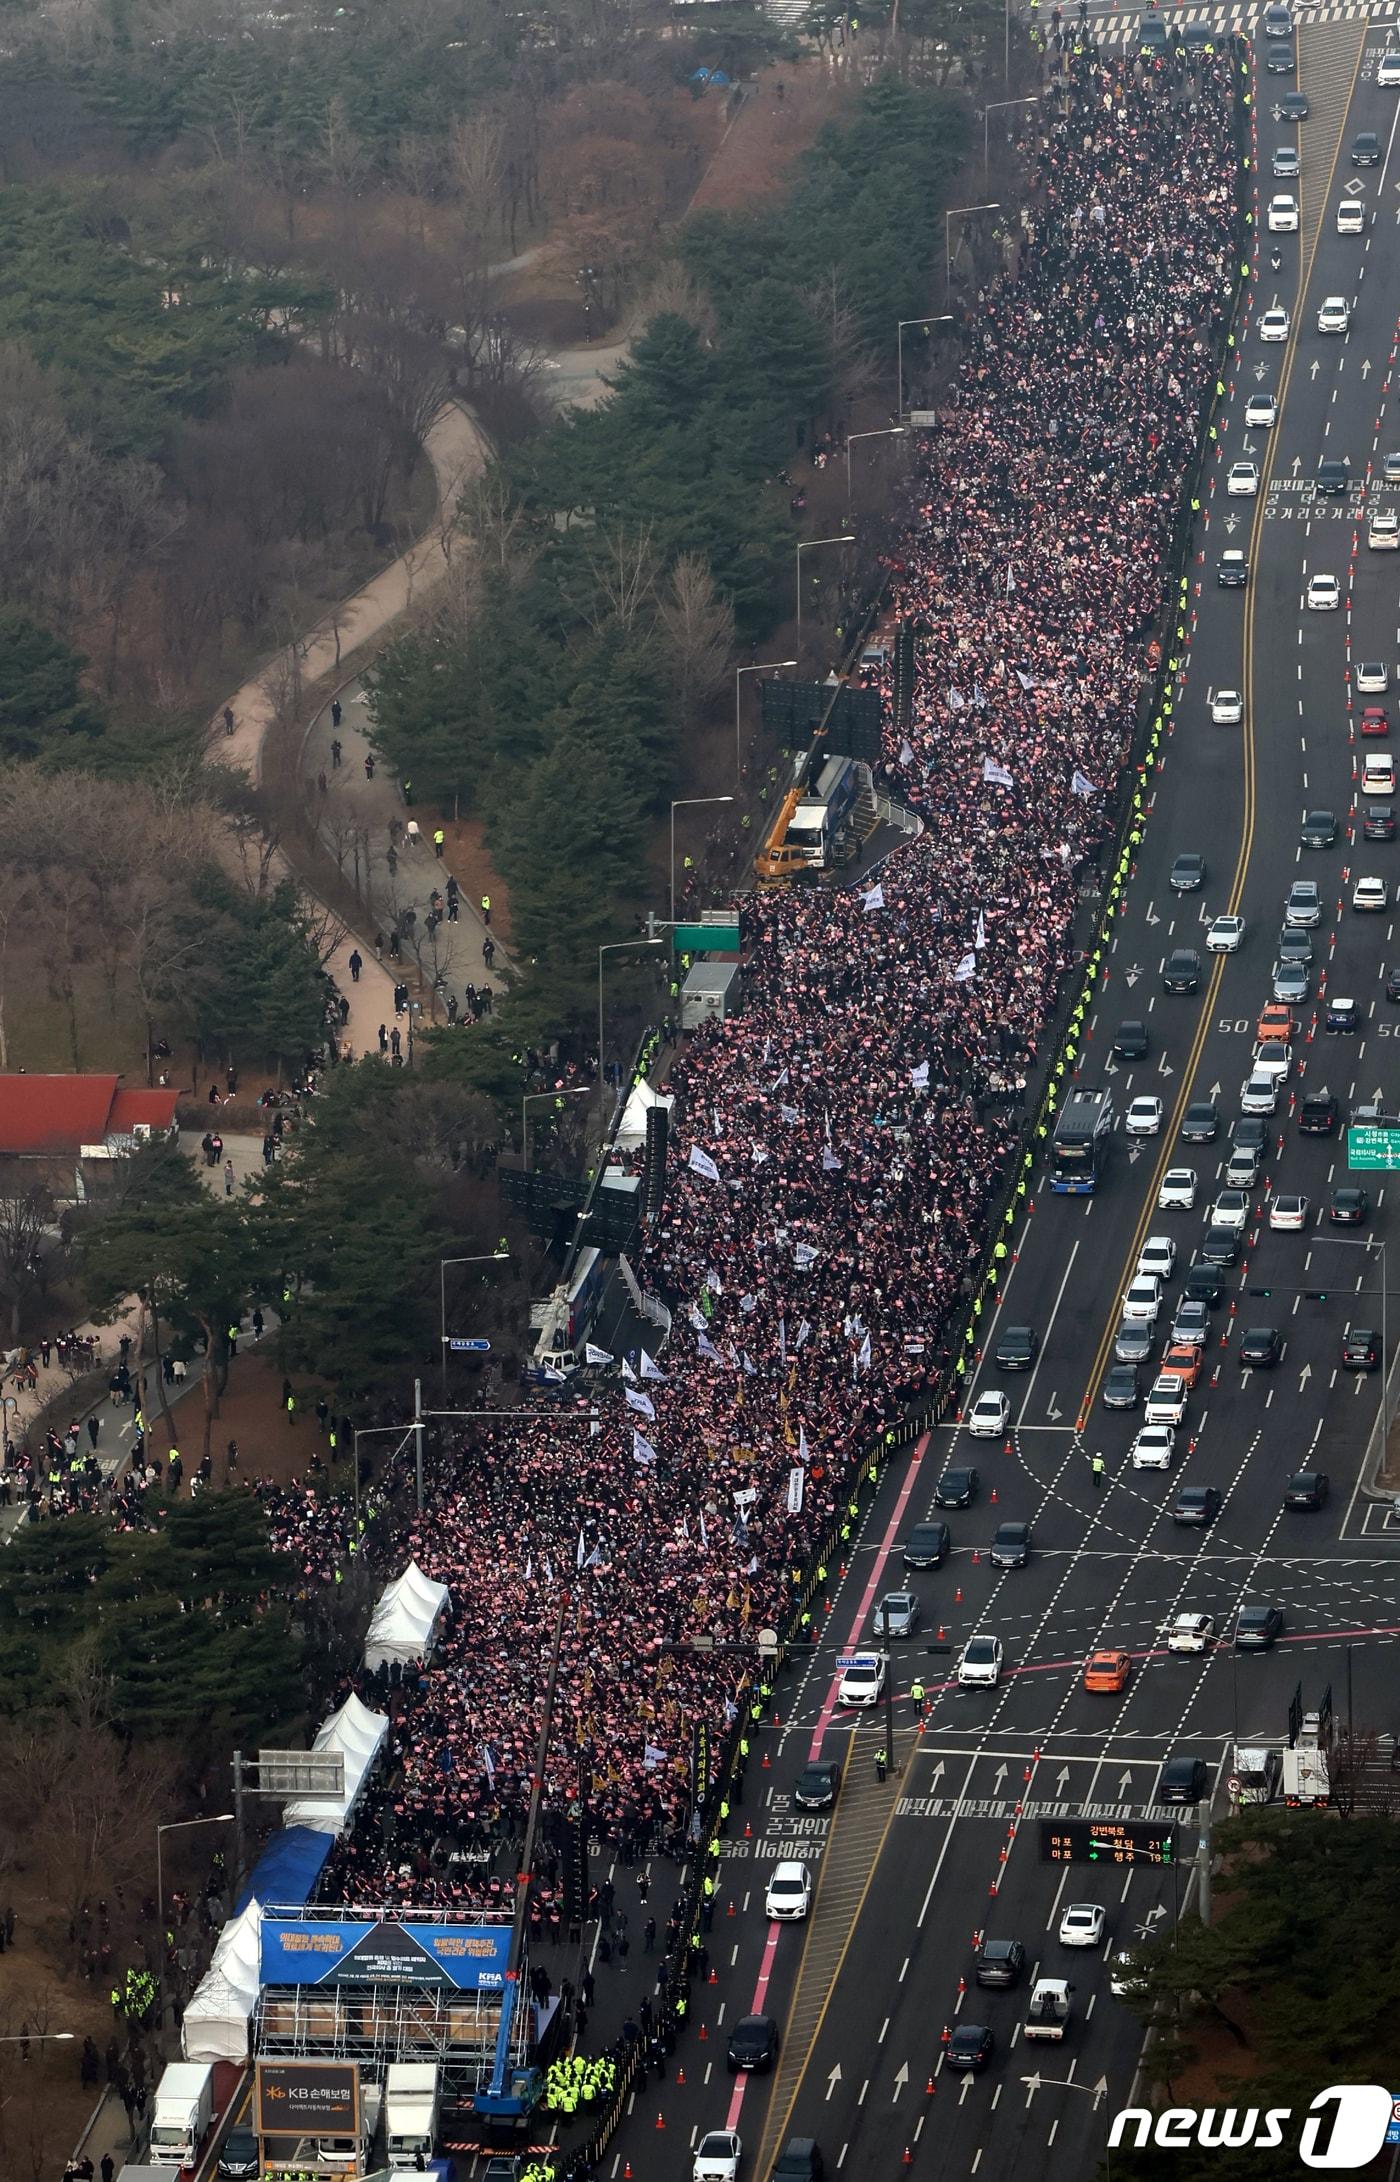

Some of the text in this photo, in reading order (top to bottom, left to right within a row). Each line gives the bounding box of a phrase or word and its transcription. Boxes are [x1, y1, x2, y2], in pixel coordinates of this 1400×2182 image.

[1269, 479, 1315, 491] 마포대교
[1264, 507, 1310, 519] 오거리
[1218, 1019, 1249, 1033] 50
[697, 1724, 707, 1792] 서울시의사회
[895, 1797, 957, 1816] 마포대교
[765, 1817, 831, 1835] 지하도로
[1090, 1826, 1126, 1837] 강변북로
[288, 2088, 308, 2099] KB
[310, 2088, 351, 2100] 손해보험
